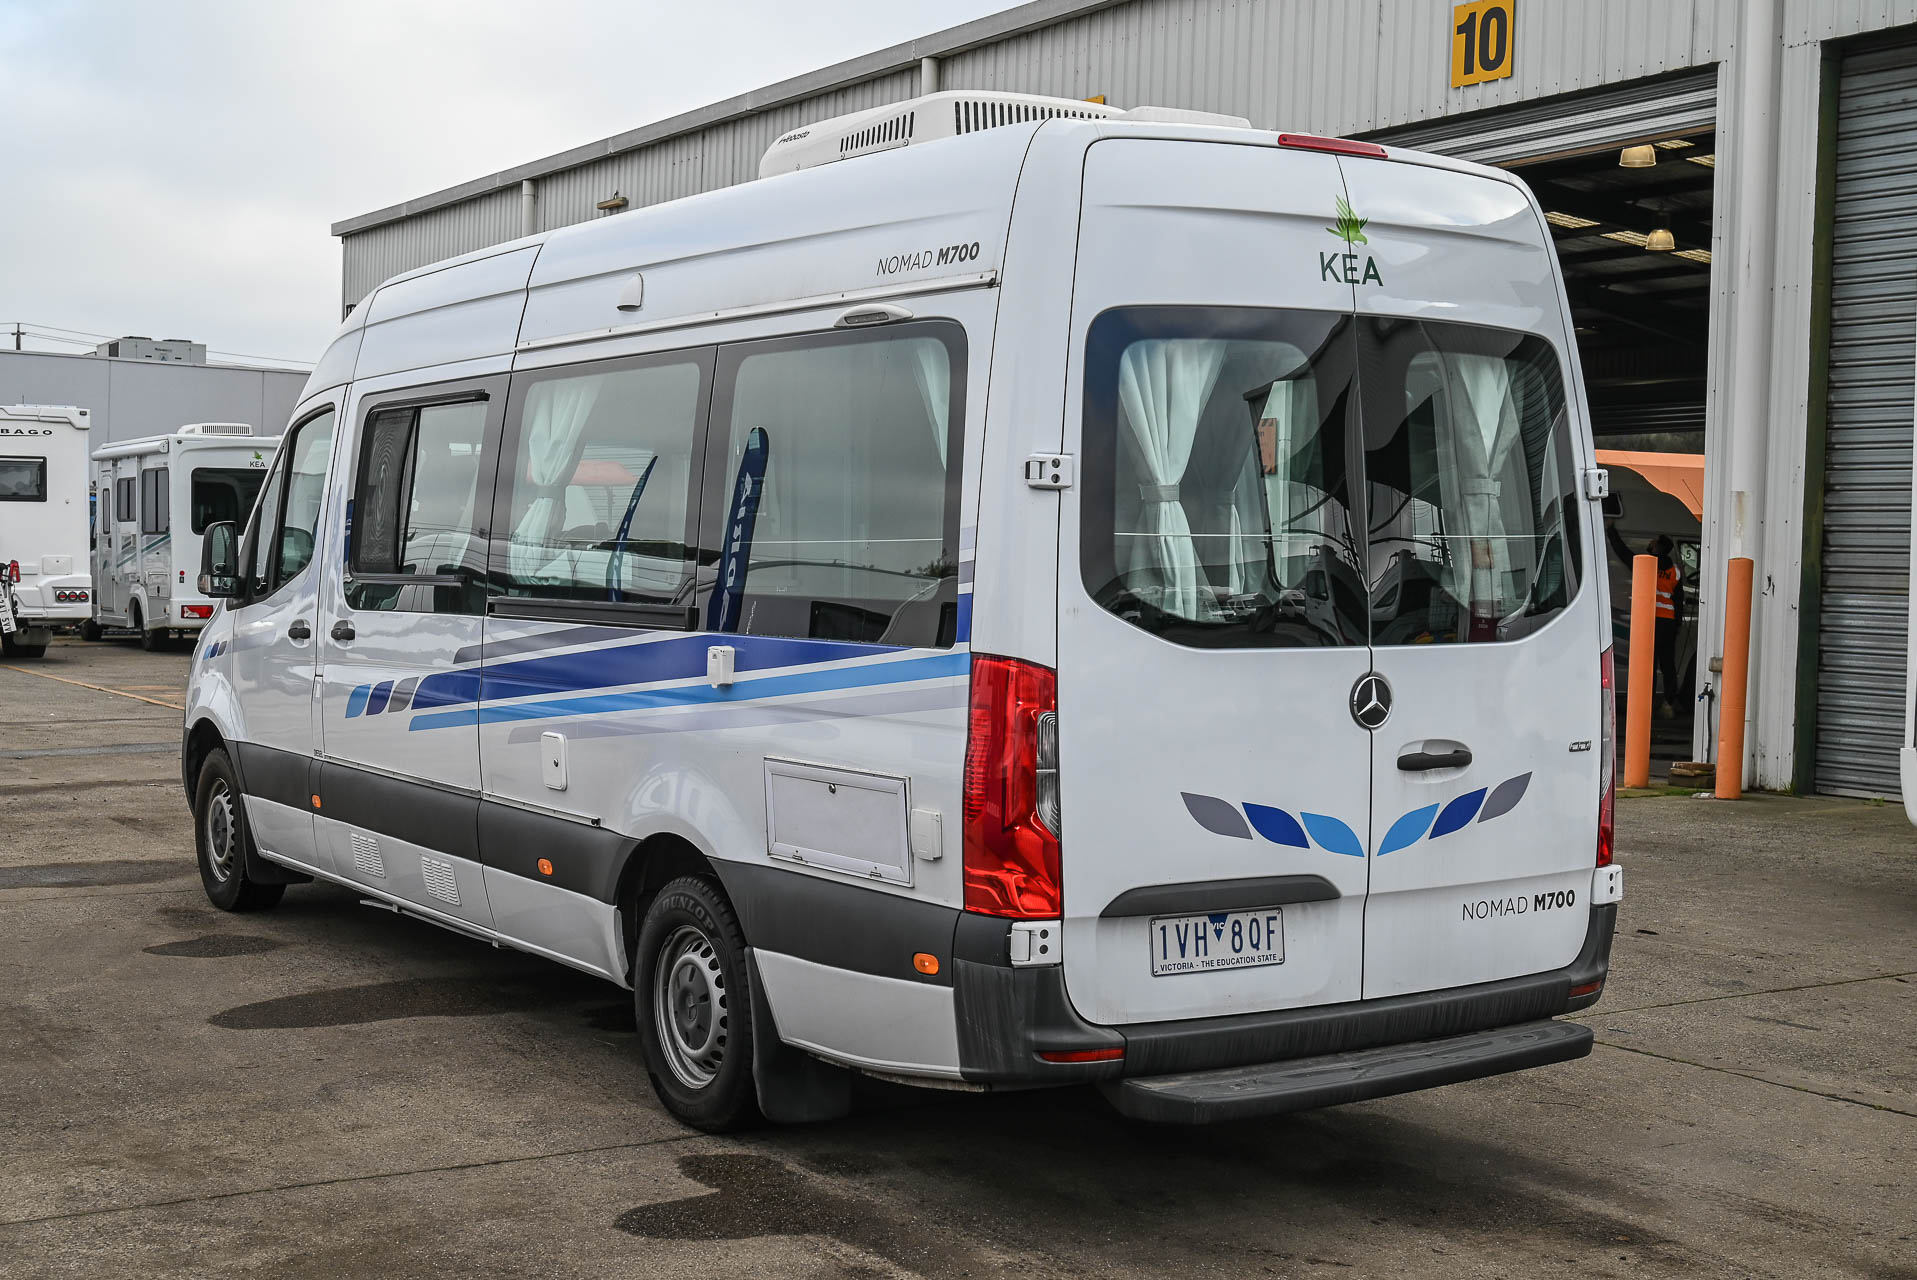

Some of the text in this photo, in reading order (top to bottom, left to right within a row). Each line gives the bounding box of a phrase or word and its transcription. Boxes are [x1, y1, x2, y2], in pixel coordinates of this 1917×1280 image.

[1456, 6, 1508, 76] 10
[876, 241, 980, 276] NOMAD M700
[1319, 251, 1384, 287] KEA
[0, 428, 53, 436] BAGO
[662, 895, 714, 930] DUNLOP
[1462, 889, 1576, 921] NOMAD M700
[1159, 915, 1278, 960] 1VH 8QF
[1211, 921, 1225, 931] VIC
[1160, 961, 1195, 972] VICTORIA
[1201, 959, 1215, 968] THE
[1216, 954, 1256, 967] EDUCATION
[1257, 953, 1277, 963] STATE
